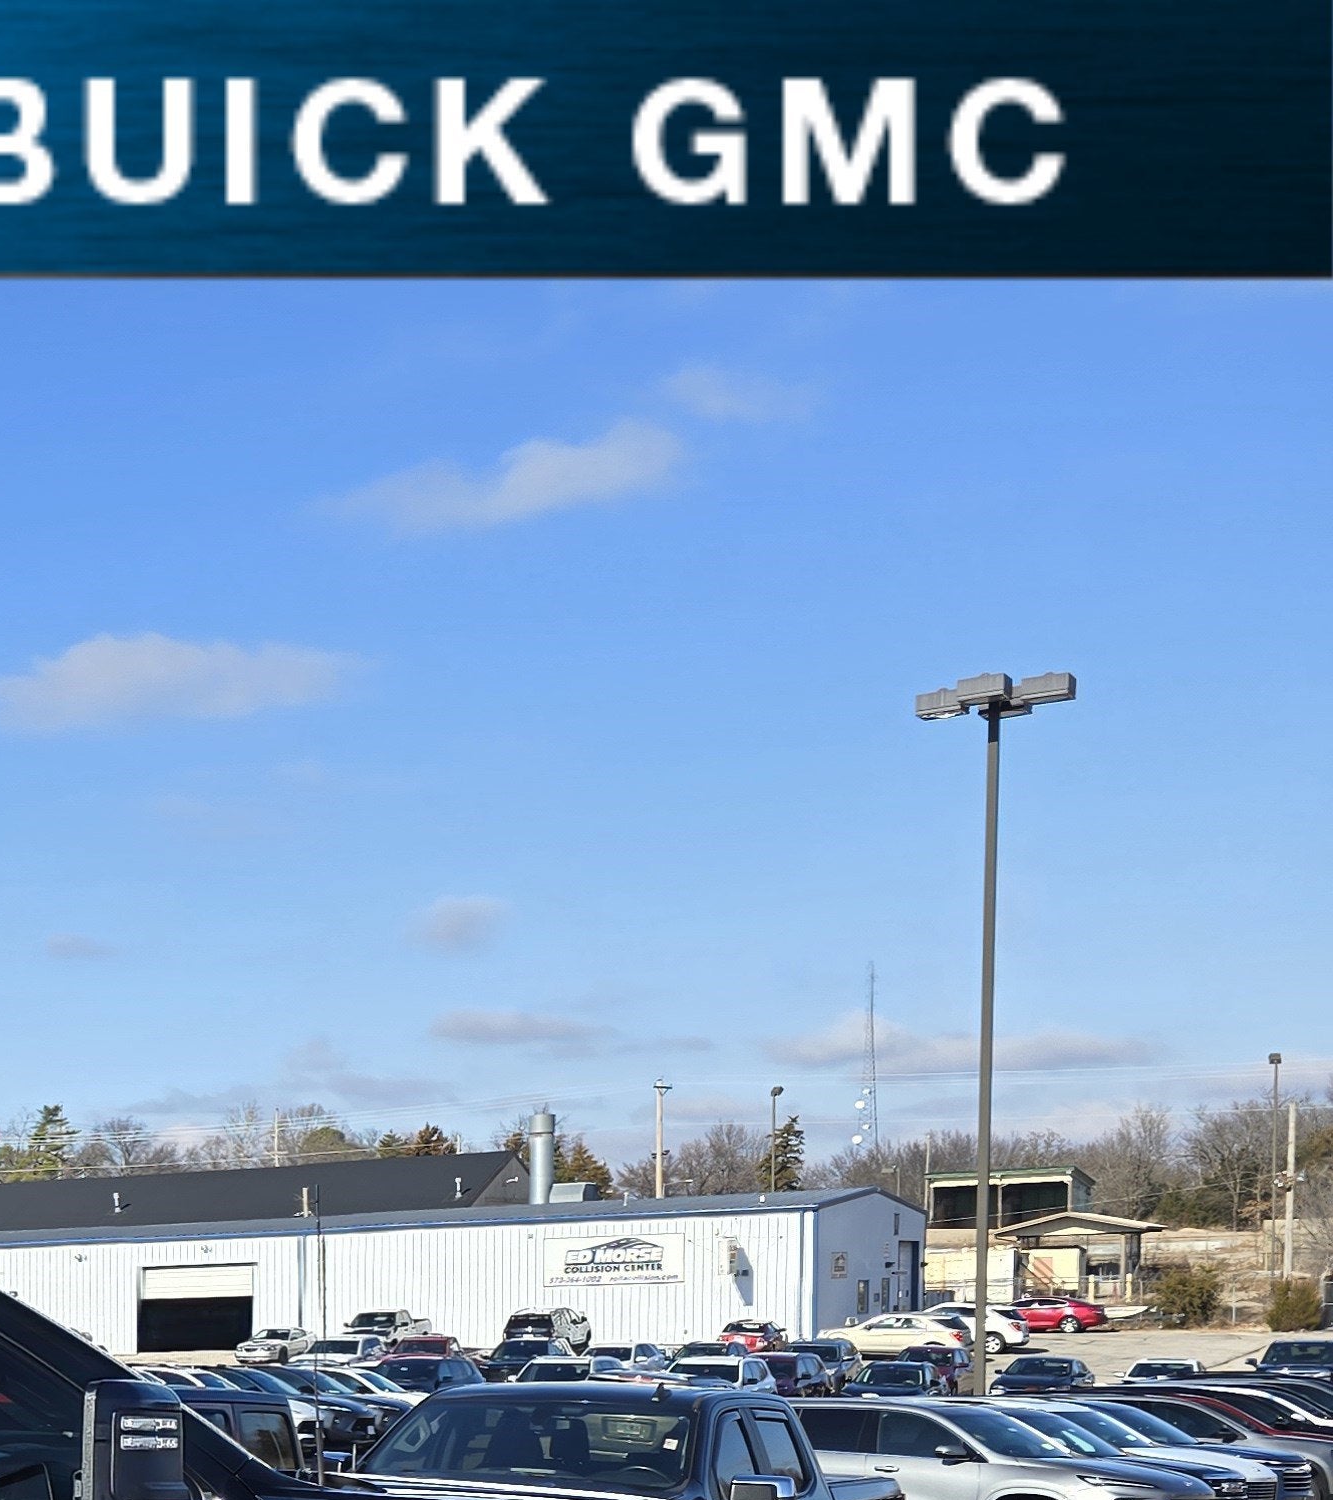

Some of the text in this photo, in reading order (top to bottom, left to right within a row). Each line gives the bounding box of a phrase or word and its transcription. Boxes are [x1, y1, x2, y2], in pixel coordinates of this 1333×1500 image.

[564, 1246, 664, 1266] ED MORSE
[564, 1263, 663, 1274] COLLISION CENTER
